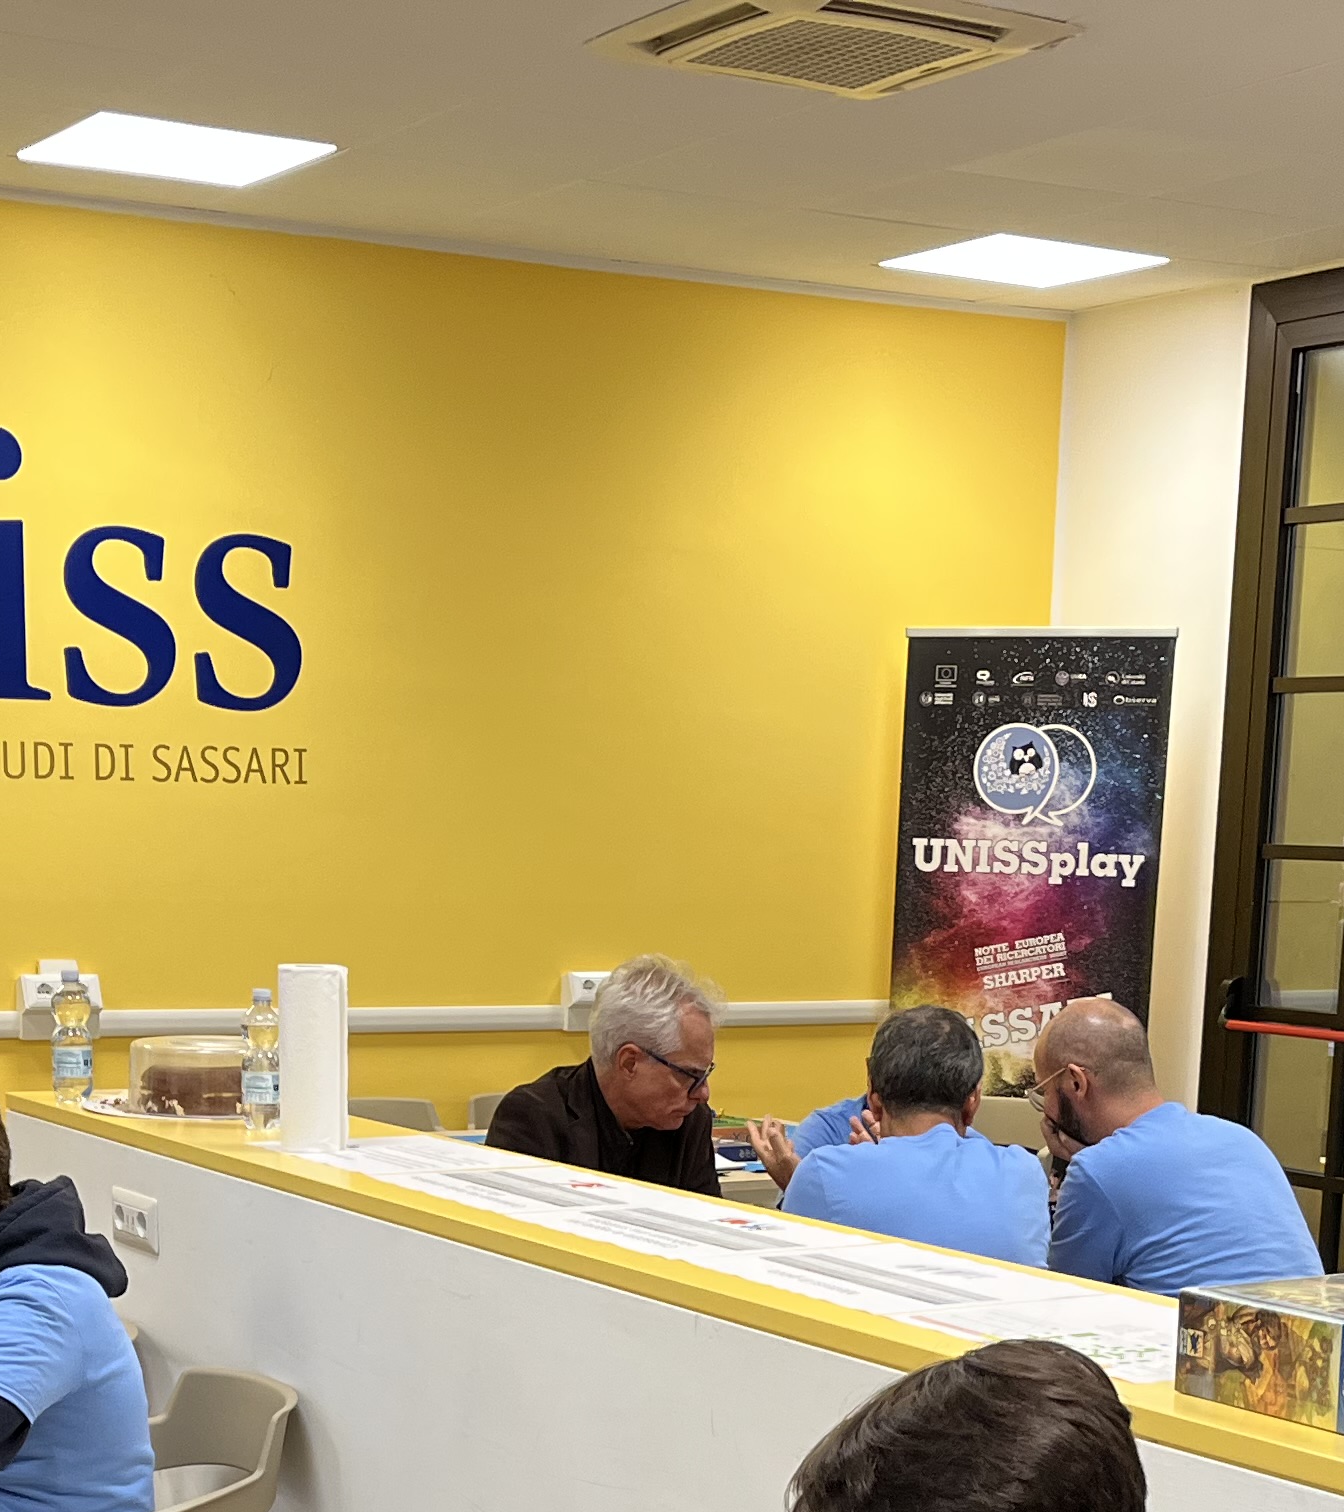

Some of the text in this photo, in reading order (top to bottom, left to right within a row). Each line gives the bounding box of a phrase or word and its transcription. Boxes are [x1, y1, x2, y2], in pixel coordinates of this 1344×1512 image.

[94, 742, 135, 783] DI
[151, 744, 309, 786] SASSARI
[912, 837, 1146, 888] UNISSplay
[974, 932, 1066, 958] NOTTE EUROPEA
[975, 941, 1066, 966] DEI RICERCATORI
[983, 962, 1066, 990] SHARPER
